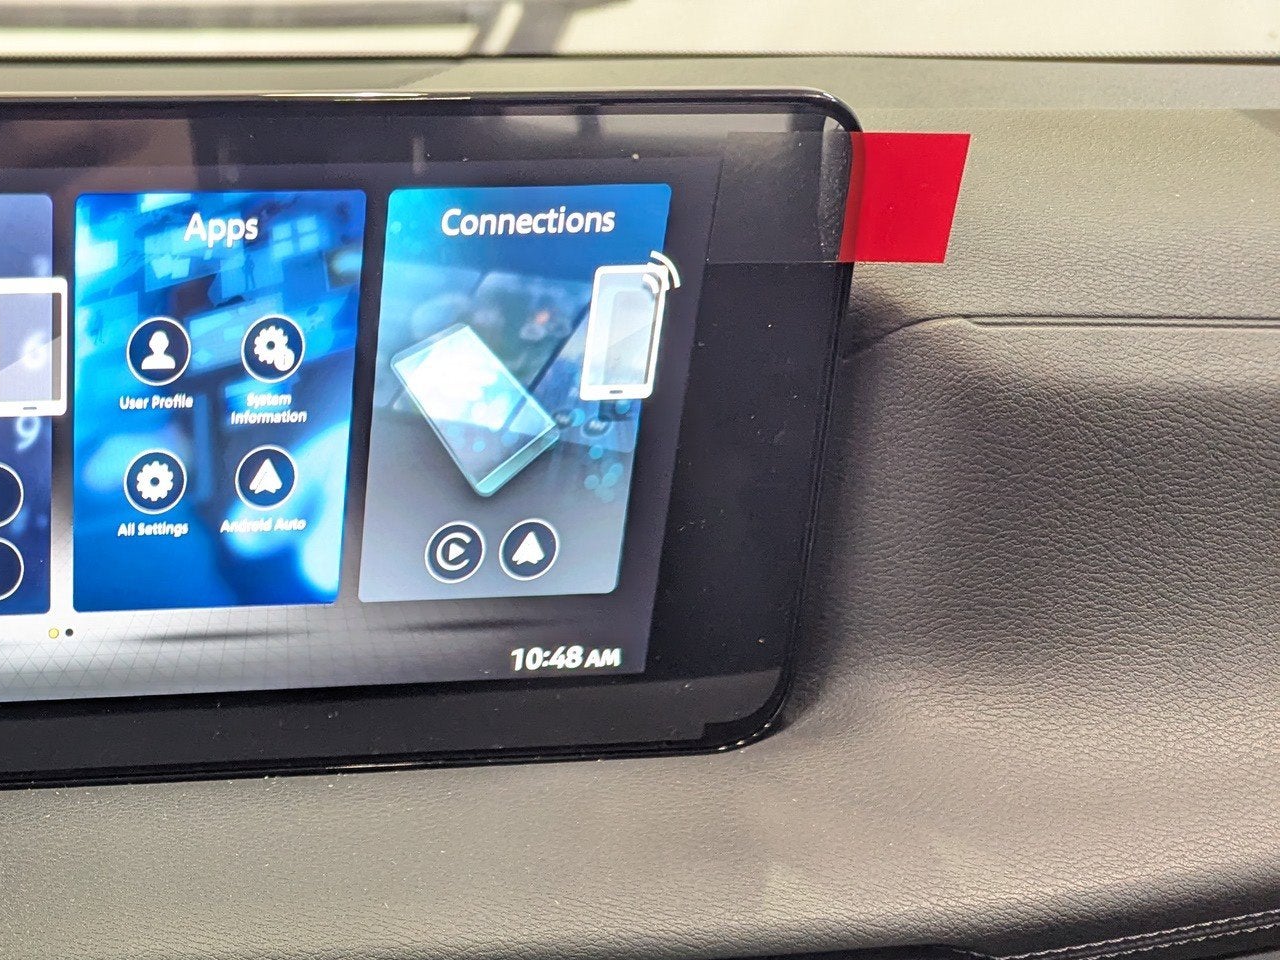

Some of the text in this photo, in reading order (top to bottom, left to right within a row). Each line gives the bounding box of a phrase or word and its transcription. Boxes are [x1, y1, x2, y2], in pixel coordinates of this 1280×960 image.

[183, 212, 259, 248] Apps
[441, 206, 616, 237] Connections
[119, 393, 194, 410] User Profile
[246, 392, 293, 408] System
[230, 409, 308, 425] Information
[117, 520, 189, 538] All Settings
[220, 518, 307, 534] Android Auto
[510, 645, 622, 672] 10:48 AM
